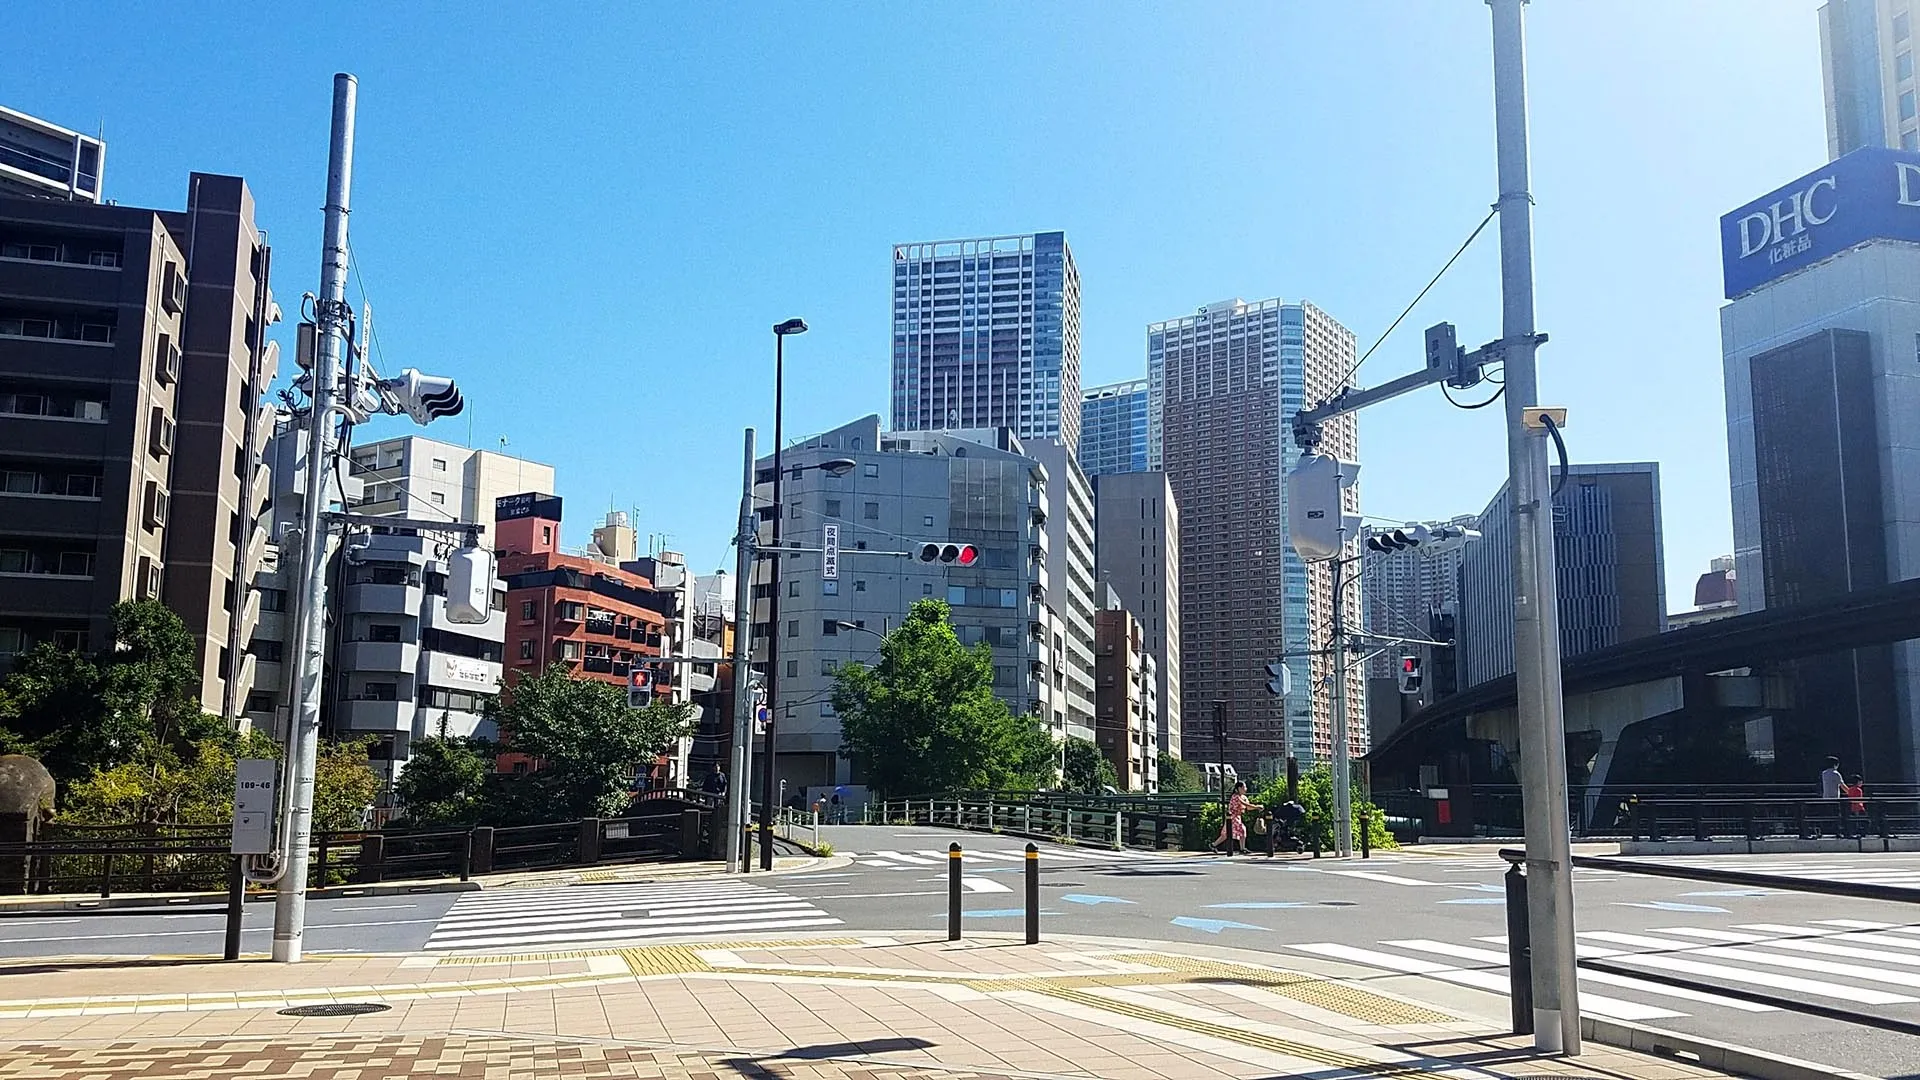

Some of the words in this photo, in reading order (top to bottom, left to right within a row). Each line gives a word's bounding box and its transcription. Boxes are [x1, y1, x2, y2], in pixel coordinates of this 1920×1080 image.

[1737, 175, 1838, 259] DHC
[1768, 233, 1812, 265] 化粧品
[826, 527, 836, 576] 夜間点滅式
